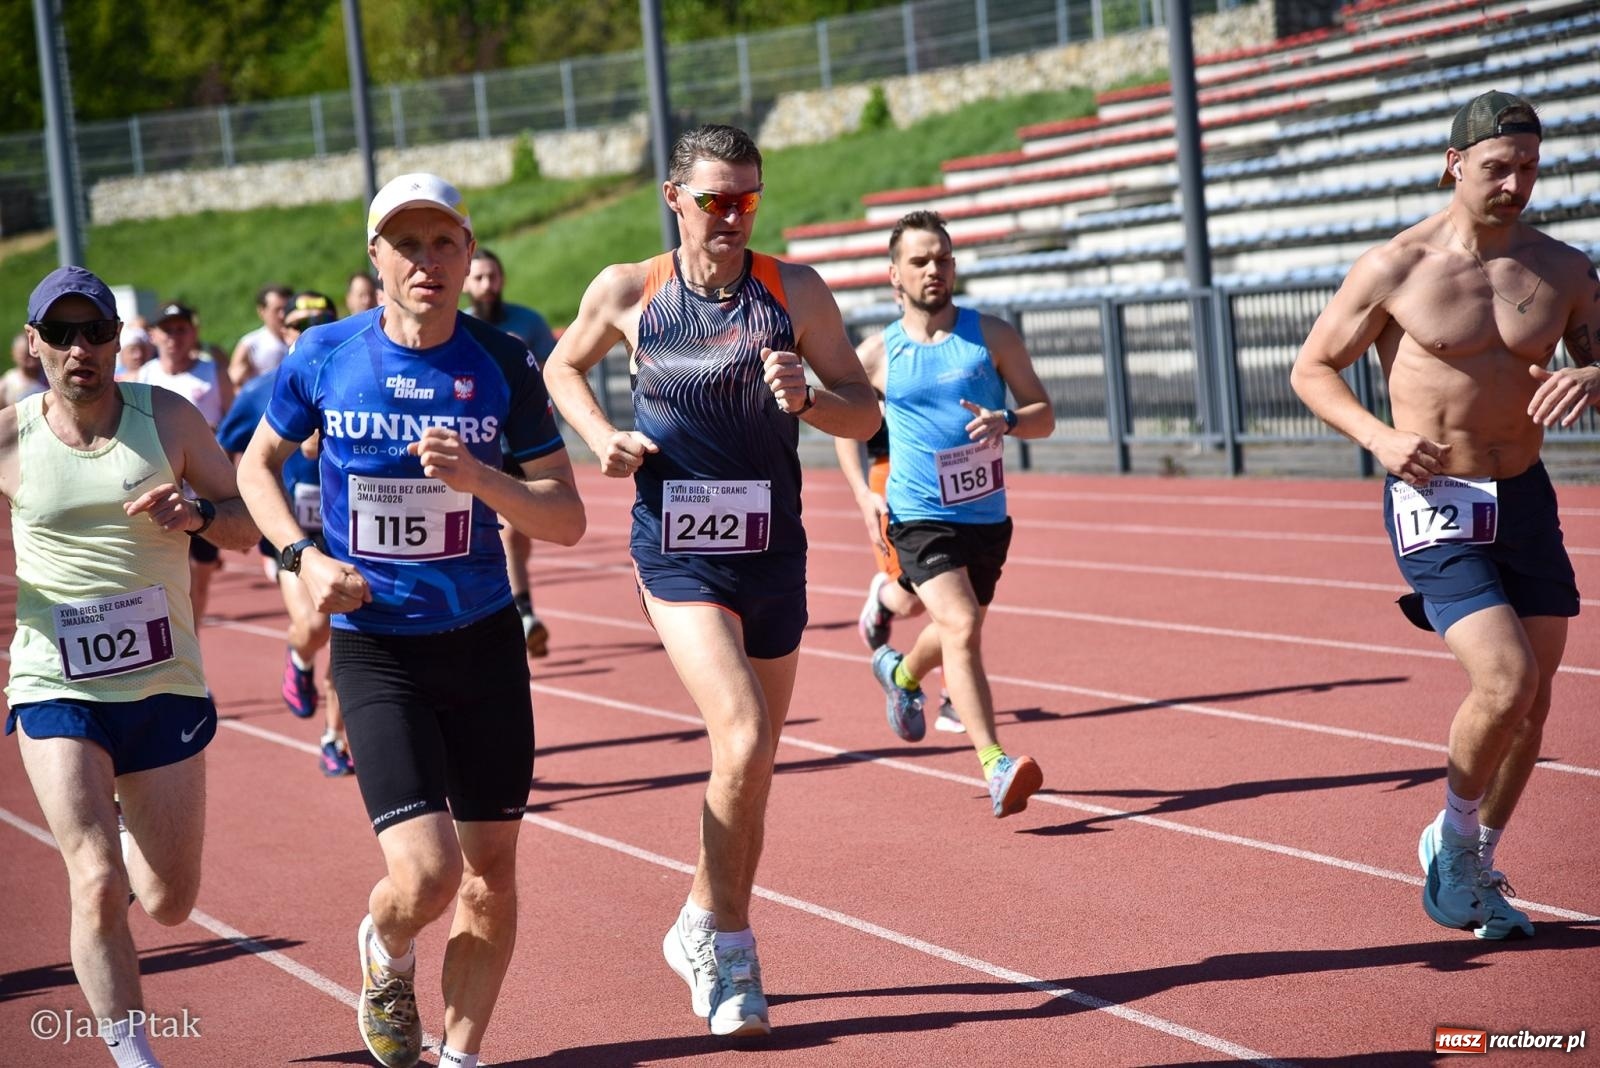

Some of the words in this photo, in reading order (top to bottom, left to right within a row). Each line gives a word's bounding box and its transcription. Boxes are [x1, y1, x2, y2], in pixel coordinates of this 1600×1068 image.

[352, 445, 407, 457] EKO-OK
[950, 466, 988, 494] 158
[1430, 480, 1444, 488] BEZ
[357, 483, 376, 493] XVIII
[378, 484, 397, 494] BIEG
[399, 484, 414, 494] BEZ
[416, 485, 446, 494] GRANIC
[670, 485, 687, 494] XVIII
[689, 486, 705, 494] BIEG
[707, 486, 720, 495] BEZ
[721, 486, 748, 495] GRANIC
[357, 492, 403, 504] 3MAJA2026
[670, 494, 711, 503] 3MAJA2026
[677, 513, 739, 540] 242
[1411, 504, 1460, 536] 172
[375, 515, 428, 546] 115
[60, 608, 78, 618] XVIII
[80, 605, 98, 615] BIEG
[99, 603, 113, 612] BEZ
[115, 597, 143, 609] GRANIC
[62, 613, 105, 627] 3MAJA2026
[77, 628, 140, 666] 102
